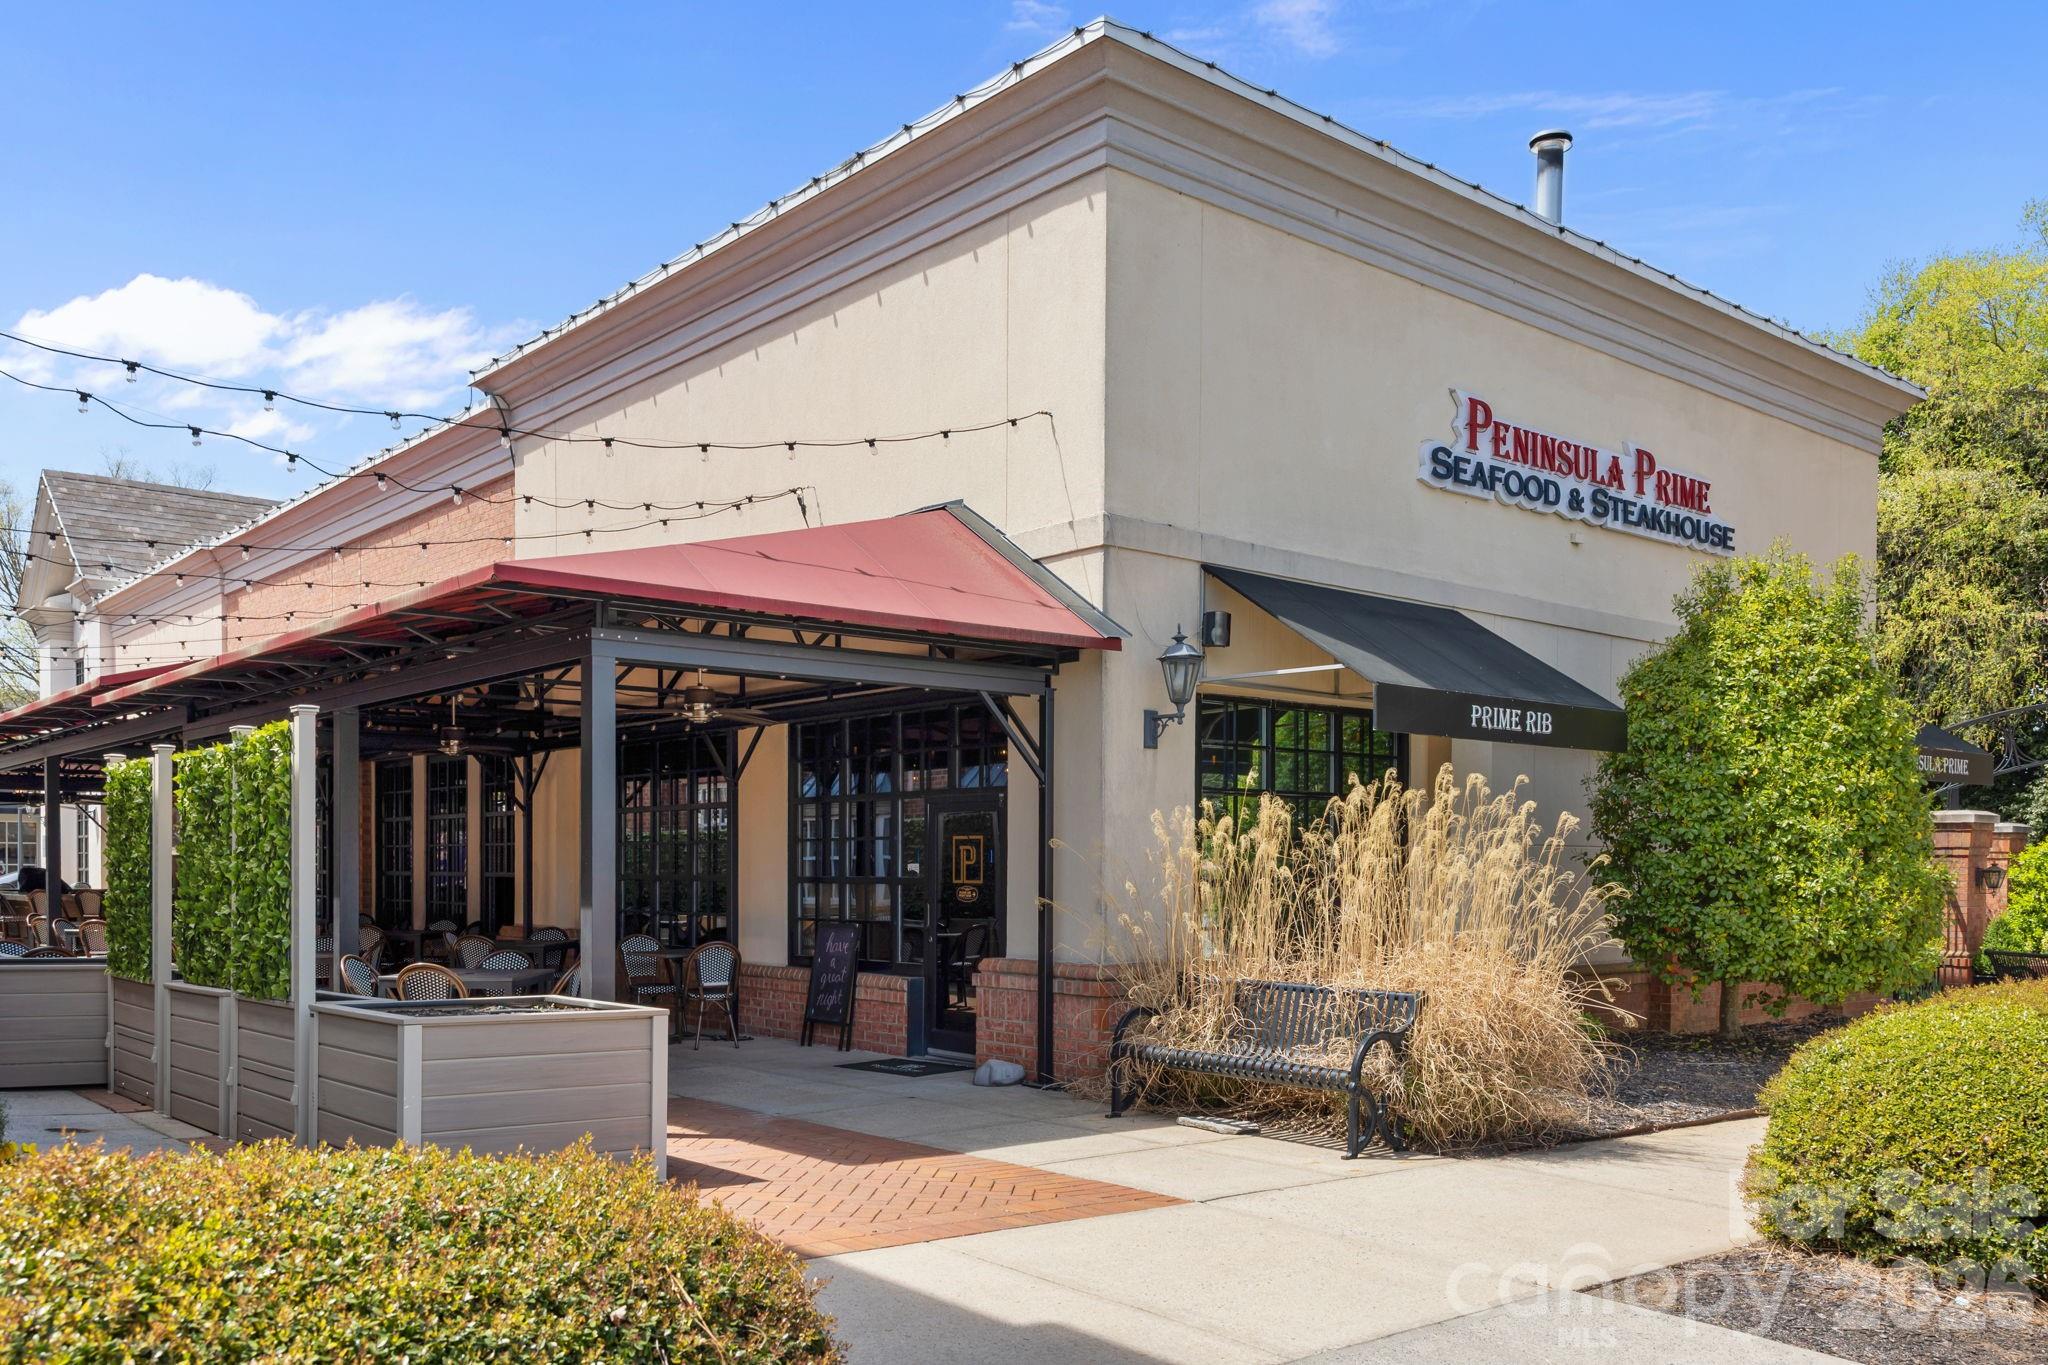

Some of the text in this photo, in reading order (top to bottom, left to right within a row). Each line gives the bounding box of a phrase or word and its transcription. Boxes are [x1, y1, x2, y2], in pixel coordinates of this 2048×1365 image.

[1464, 396, 1711, 514] PENINSULA PRIME
[1431, 446, 1735, 551] SEAFOOD & STEAKHOUSE
[1471, 705, 1552, 735] PRIME RIB
[1943, 757, 1968, 775] PRIME
[825, 931, 850, 954] have
[830, 957, 836, 969] a
[820, 965, 847, 990] great
[816, 988, 844, 1012] night
